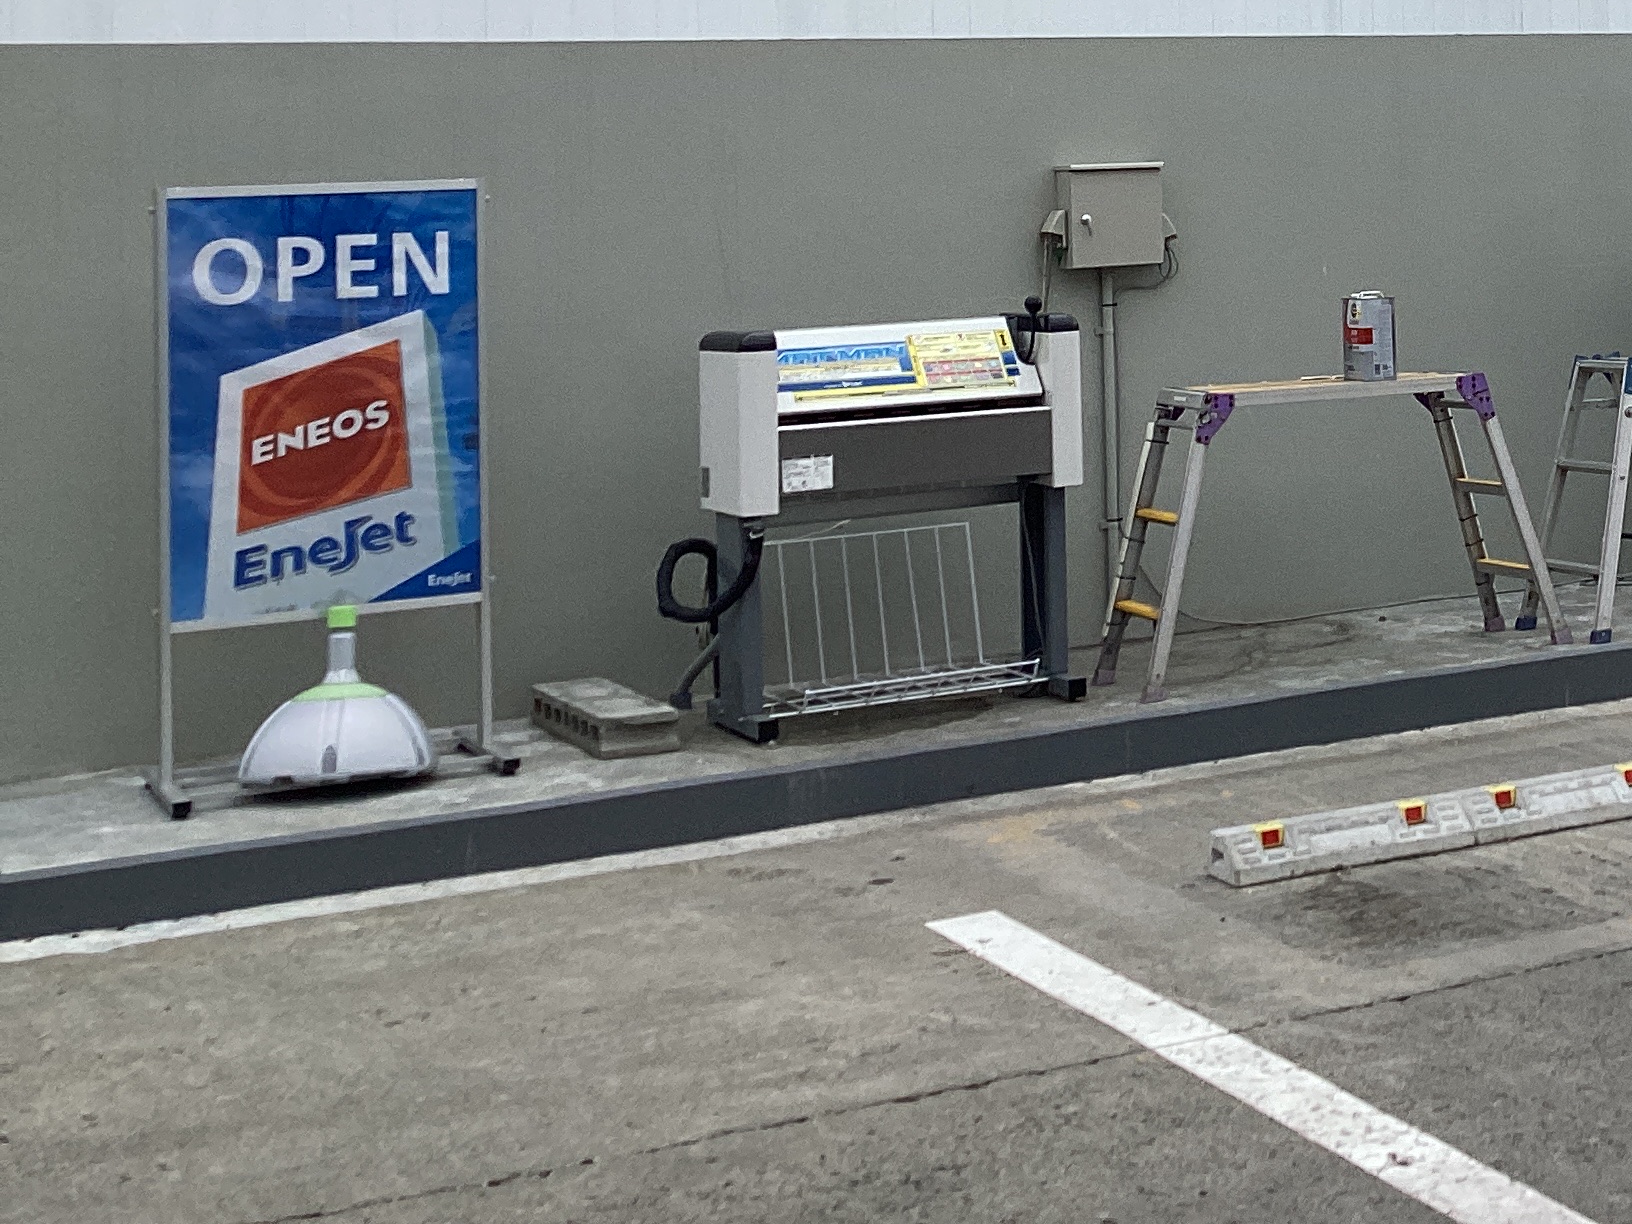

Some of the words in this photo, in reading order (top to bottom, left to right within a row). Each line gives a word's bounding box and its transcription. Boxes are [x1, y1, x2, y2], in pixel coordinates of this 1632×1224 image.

[192, 229, 450, 306] OPEN
[250, 398, 391, 467] ENEOS
[233, 510, 417, 591] EneJet
